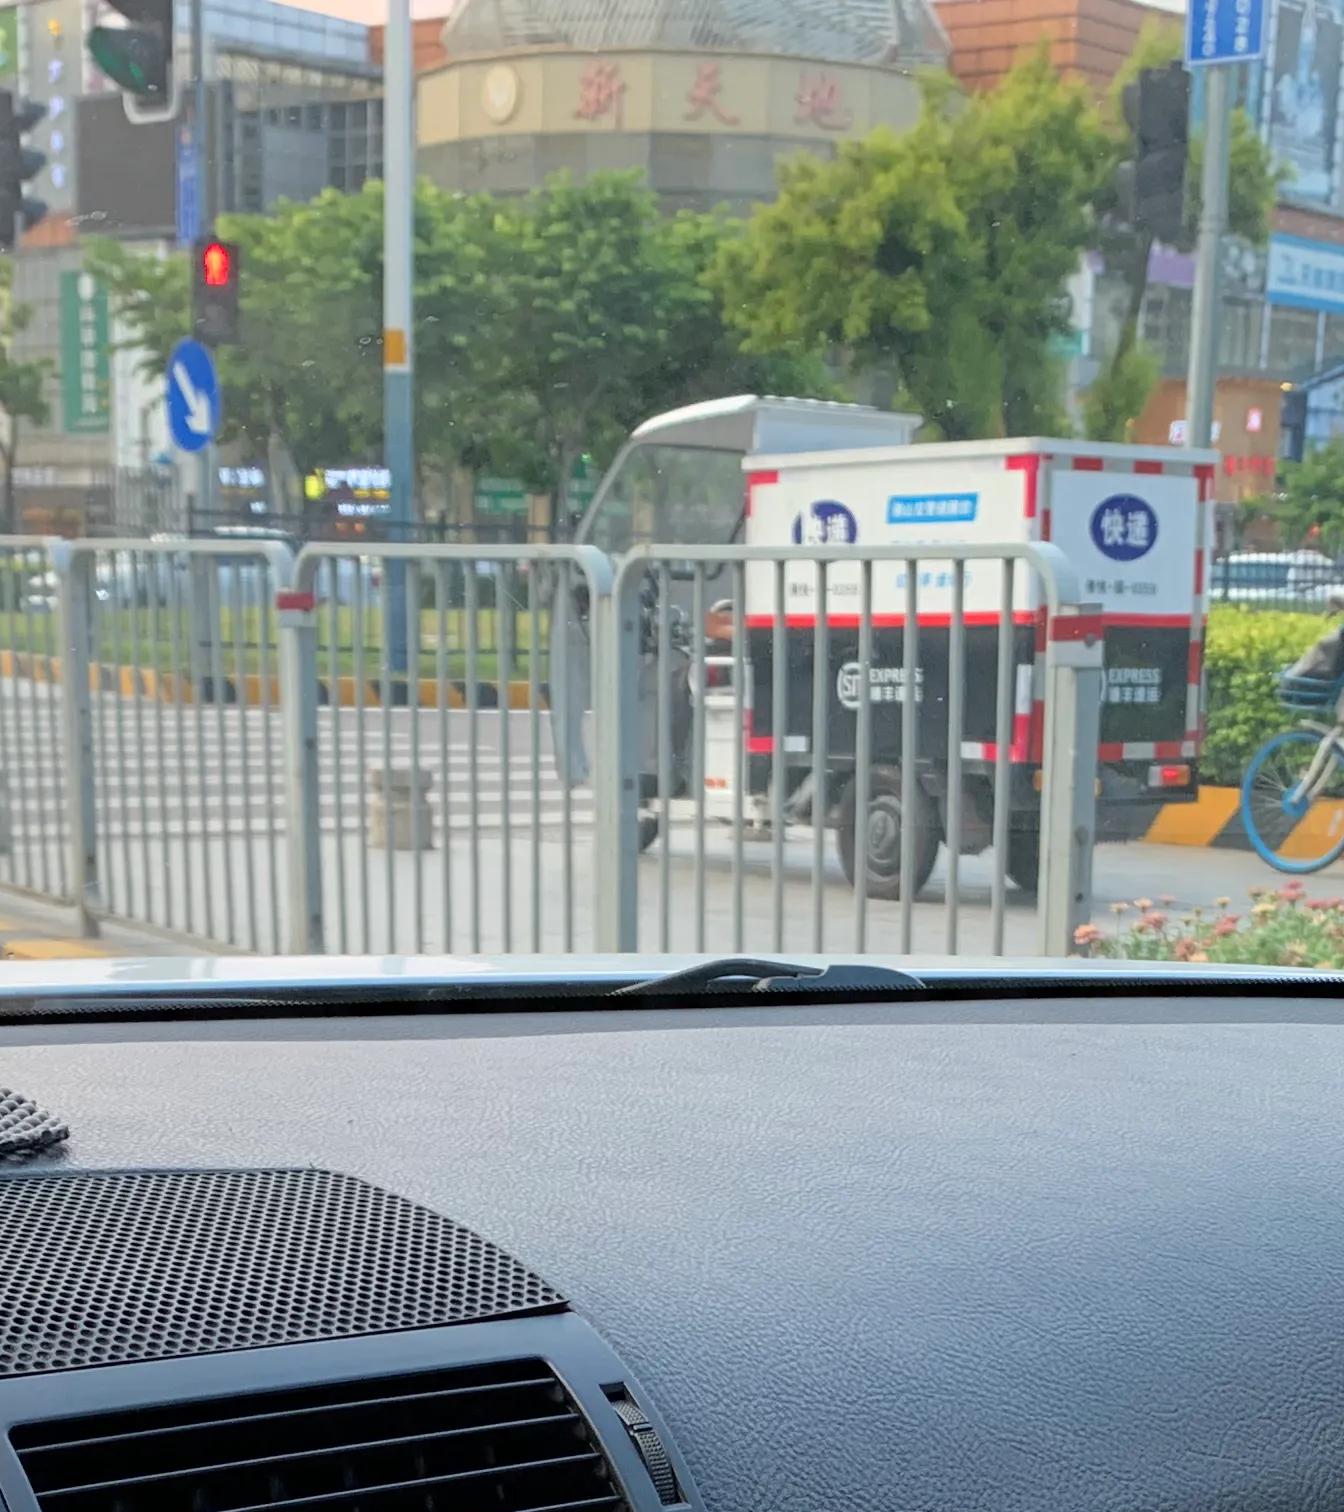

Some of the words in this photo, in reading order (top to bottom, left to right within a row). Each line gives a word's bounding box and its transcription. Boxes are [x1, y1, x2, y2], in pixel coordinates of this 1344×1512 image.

[573, 60, 852, 132] 新天地
[1108, 668, 1162, 684] EXPRESS
